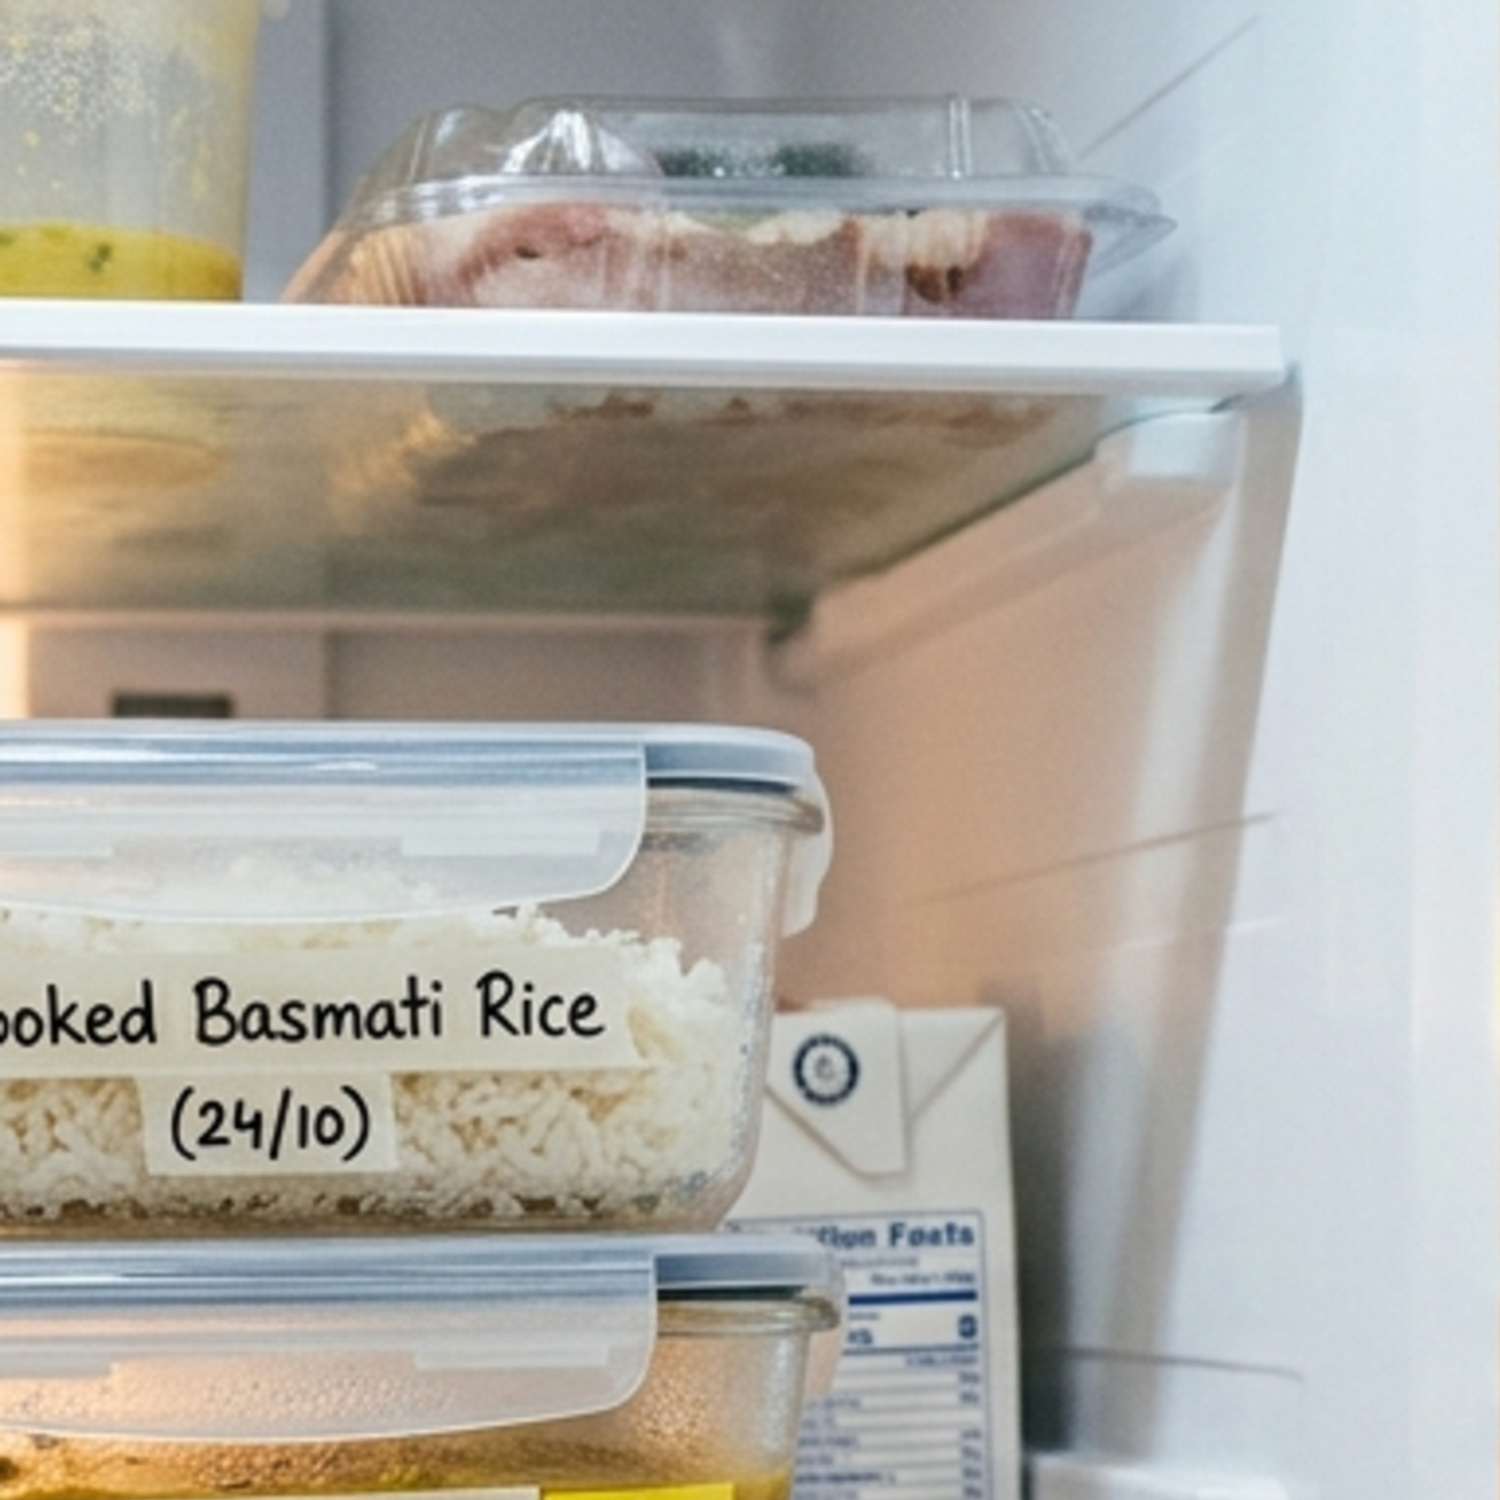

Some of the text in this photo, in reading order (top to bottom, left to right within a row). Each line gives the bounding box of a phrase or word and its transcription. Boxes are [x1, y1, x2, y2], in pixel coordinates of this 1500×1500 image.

[193, 974, 443, 1046] Basmati
[475, 970, 605, 1038] Rice
[171, 1085, 370, 1162] (24/10)
